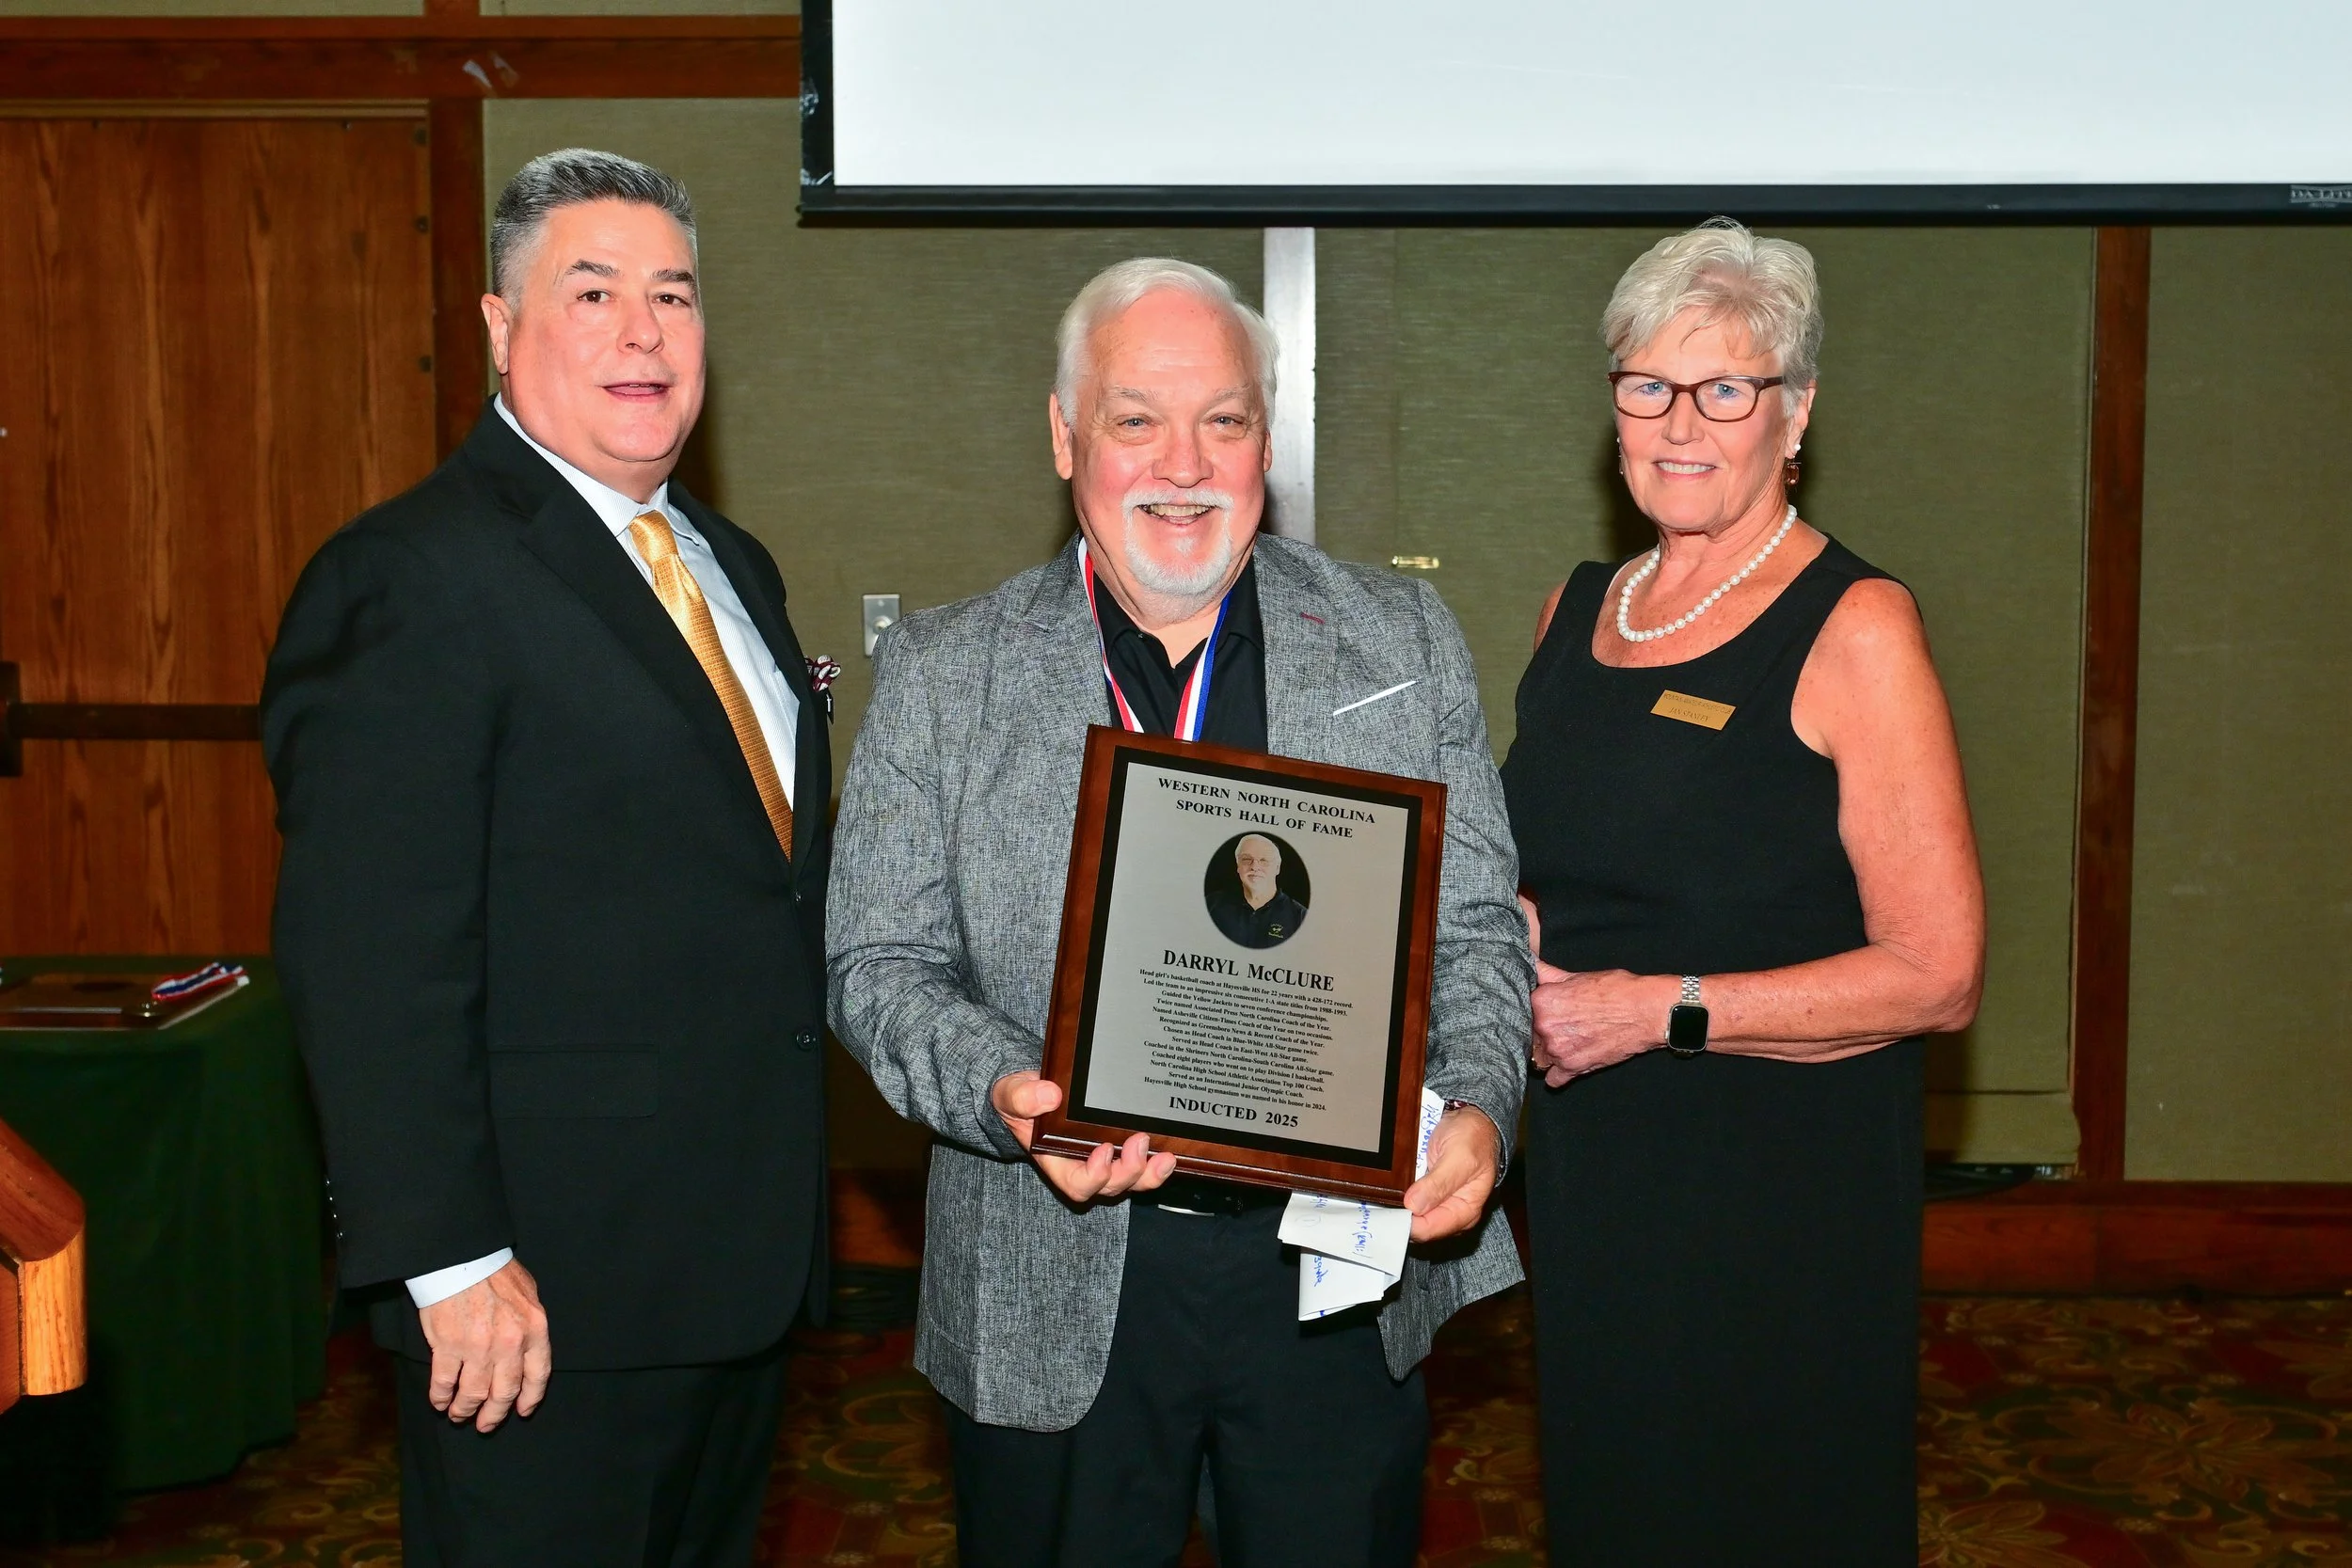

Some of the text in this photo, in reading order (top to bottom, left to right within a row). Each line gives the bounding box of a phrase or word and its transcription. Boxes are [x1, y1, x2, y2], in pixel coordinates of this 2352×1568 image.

[1158, 777, 1375, 823] WESTERN NORTH CAROLINA
[1176, 799, 1352, 838] SPORTS HALL OF FAME
[1163, 949, 1333, 991] DARRYL McCLURE
[1170, 974, 1199, 983] basketball
[1222, 982, 1250, 991] Hayesville
[1156, 997, 1172, 1006] Twice
[1193, 1004, 1222, 1013] Associated
[1256, 1014, 1280, 1022] Carolina
[1161, 990, 1182, 998] Guided
[1212, 998, 1232, 1006] Jackets
[1256, 1006, 1285, 1015] conference
[1194, 986, 1223, 996] impressive
[1232, 993, 1263, 1003] consecutive
[1319, 1006, 1347, 1016] 1988-1993.
[1152, 1006, 1171, 1014] Named
[1172, 1009, 1198, 1019] Asheville
[1199, 1013, 1236, 1024] Citizen-Times
[1159, 1016, 1190, 1025] Recognized
[1198, 1022, 1231, 1032] Greensboro
[1253, 1031, 1273, 1039] Record
[1163, 1025, 1183, 1034] Chosen
[1232, 1037, 1263, 1047] Blue-White
[1171, 1036, 1191, 1044] Served
[1199, 1039, 1214, 1048] Head
[1215, 1042, 1232, 1051] Coach
[1240, 1046, 1267, 1056] East-West
[1143, 1040, 1168, 1049] Coached
[1184, 1047, 1208, 1055] Shriners
[1227, 1053, 1269, 1066] Carolina-South
[1270, 1060, 1294, 1069] Carolina
[1295, 1065, 1317, 1073] All-Star
[1152, 1051, 1175, 1059] Coached
[1267, 1069, 1290, 1078] Division
[1144, 1076, 1172, 1085] Hayesville
[1187, 1083, 1206, 1091] School
[1207, 1087, 1239, 1097] gymnasium
[1168, 1062, 1192, 1071] Carolina
[1227, 1071, 1248, 1080] Athletic
[1249, 1075, 1280, 1085] Association
[1282, 1080, 1294, 1088] Top
[1204, 1076, 1240, 1087] International
[1260, 1085, 1283, 1095] Olympic
[1168, 1096, 1298, 1127] INDUCTED 2025
